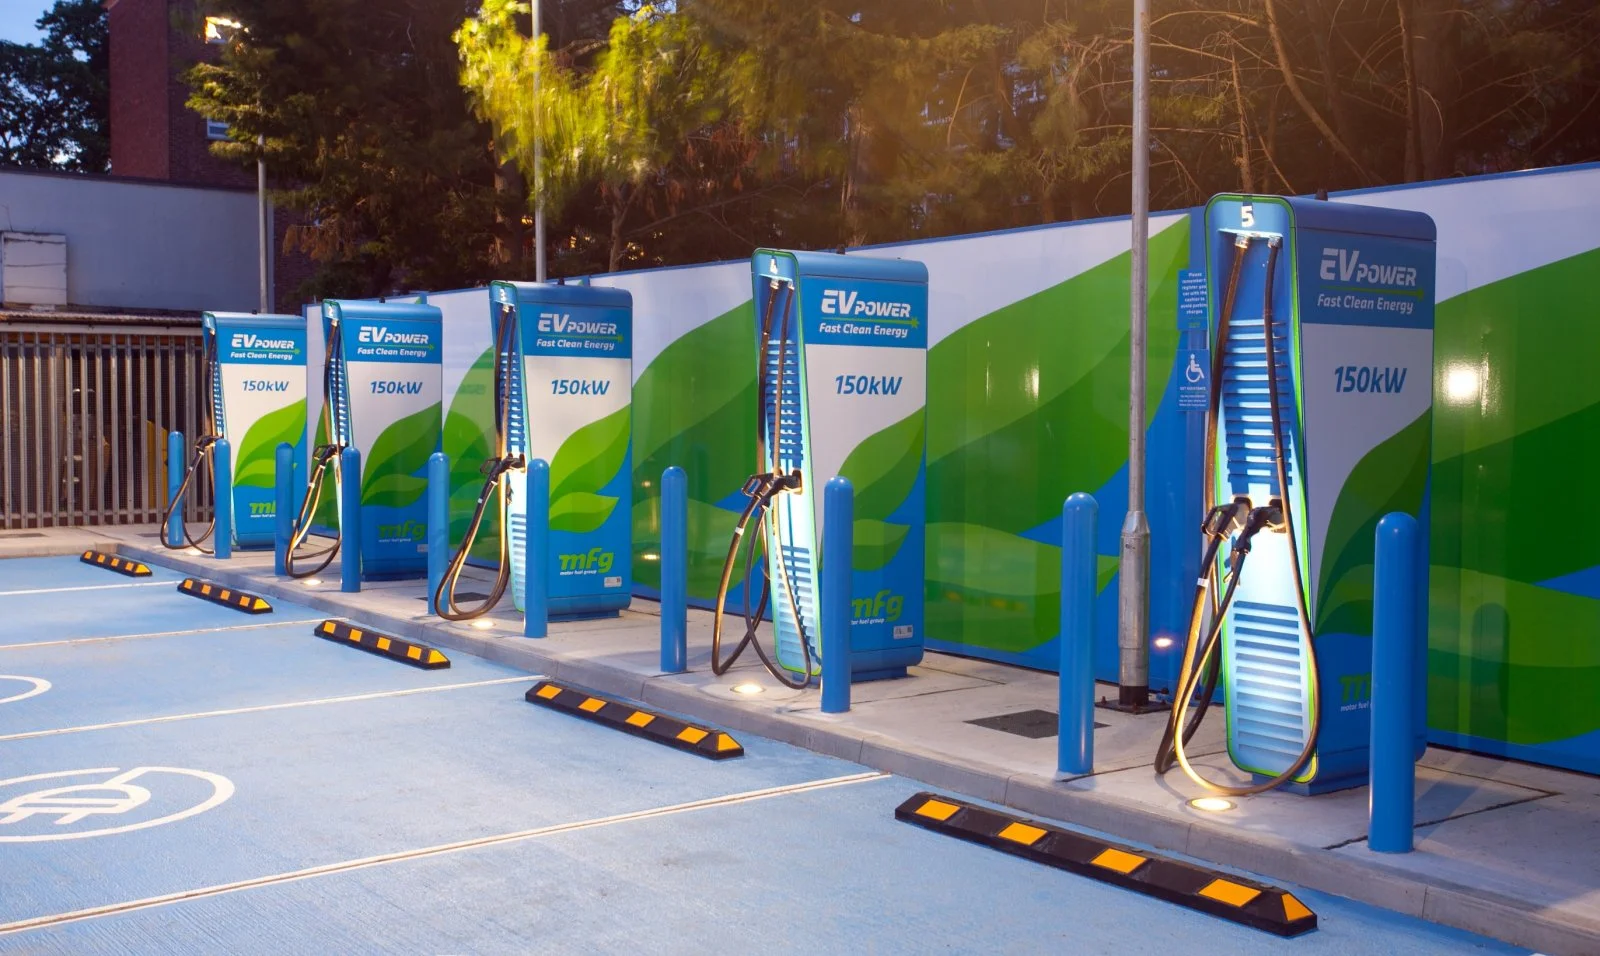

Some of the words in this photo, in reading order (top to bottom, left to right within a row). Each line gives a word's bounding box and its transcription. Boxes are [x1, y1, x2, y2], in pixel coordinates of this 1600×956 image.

[1241, 205, 1254, 228] 5
[500, 288, 506, 301] 3
[1318, 294, 1341, 307] Fast
[1344, 294, 1374, 310] Clean
[1377, 298, 1413, 315] Energy
[820, 322, 840, 333] Fast
[842, 324, 871, 334] Clean
[874, 326, 908, 338] Energy
[536, 339, 555, 347] Fast
[557, 340, 582, 348] Clean
[584, 340, 615, 350] Energy
[400, 349, 426, 357] Energy
[242, 380, 289, 391] 150kW
[370, 381, 423, 394] 150kW
[552, 380, 610, 395] 150kW
[835, 375, 903, 396] 150kW
[1334, 366, 1408, 394] 150kW
[377, 519, 425, 540] mfg
[559, 547, 614, 573] mfg
[1340, 704, 1357, 712] motor
[1358, 700, 1370, 709] fuel
